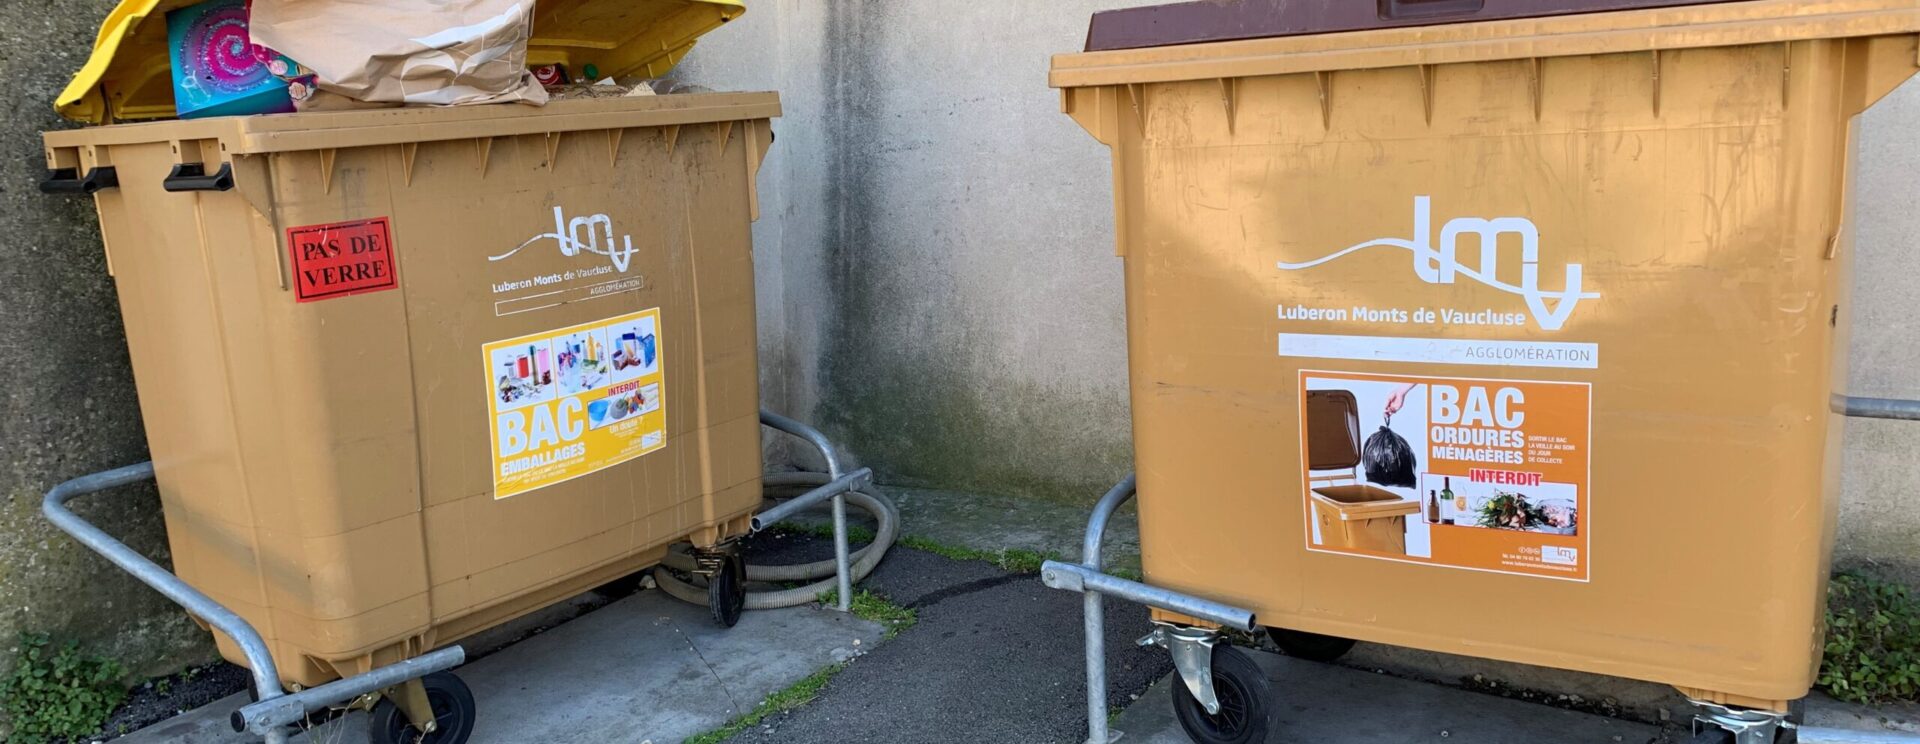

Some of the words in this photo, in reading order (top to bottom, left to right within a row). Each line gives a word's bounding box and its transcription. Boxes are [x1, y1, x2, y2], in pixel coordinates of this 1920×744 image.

[302, 239, 341, 260] PAS
[350, 234, 381, 254] DE
[304, 260, 386, 287] VERRE
[492, 281, 532, 293] Luberon
[534, 272, 562, 287] Monts
[563, 271, 575, 281] de
[1277, 304, 1347, 320] Luberon
[1352, 307, 1408, 323] Monts
[1413, 308, 1435, 323] de
[1440, 309, 1526, 325] Vaucluse
[1465, 345, 1590, 361] AGGLOMÉRATION
[607, 380, 641, 397] INTERDIT
[1431, 384, 1525, 429] BAC
[497, 396, 584, 458] BAC
[1431, 426, 1525, 448] ORDURES
[500, 442, 585, 477] EMBALLAGES
[1432, 444, 1524, 465] MÉNAGÈRES
[1470, 469, 1541, 486] INTERDIT
